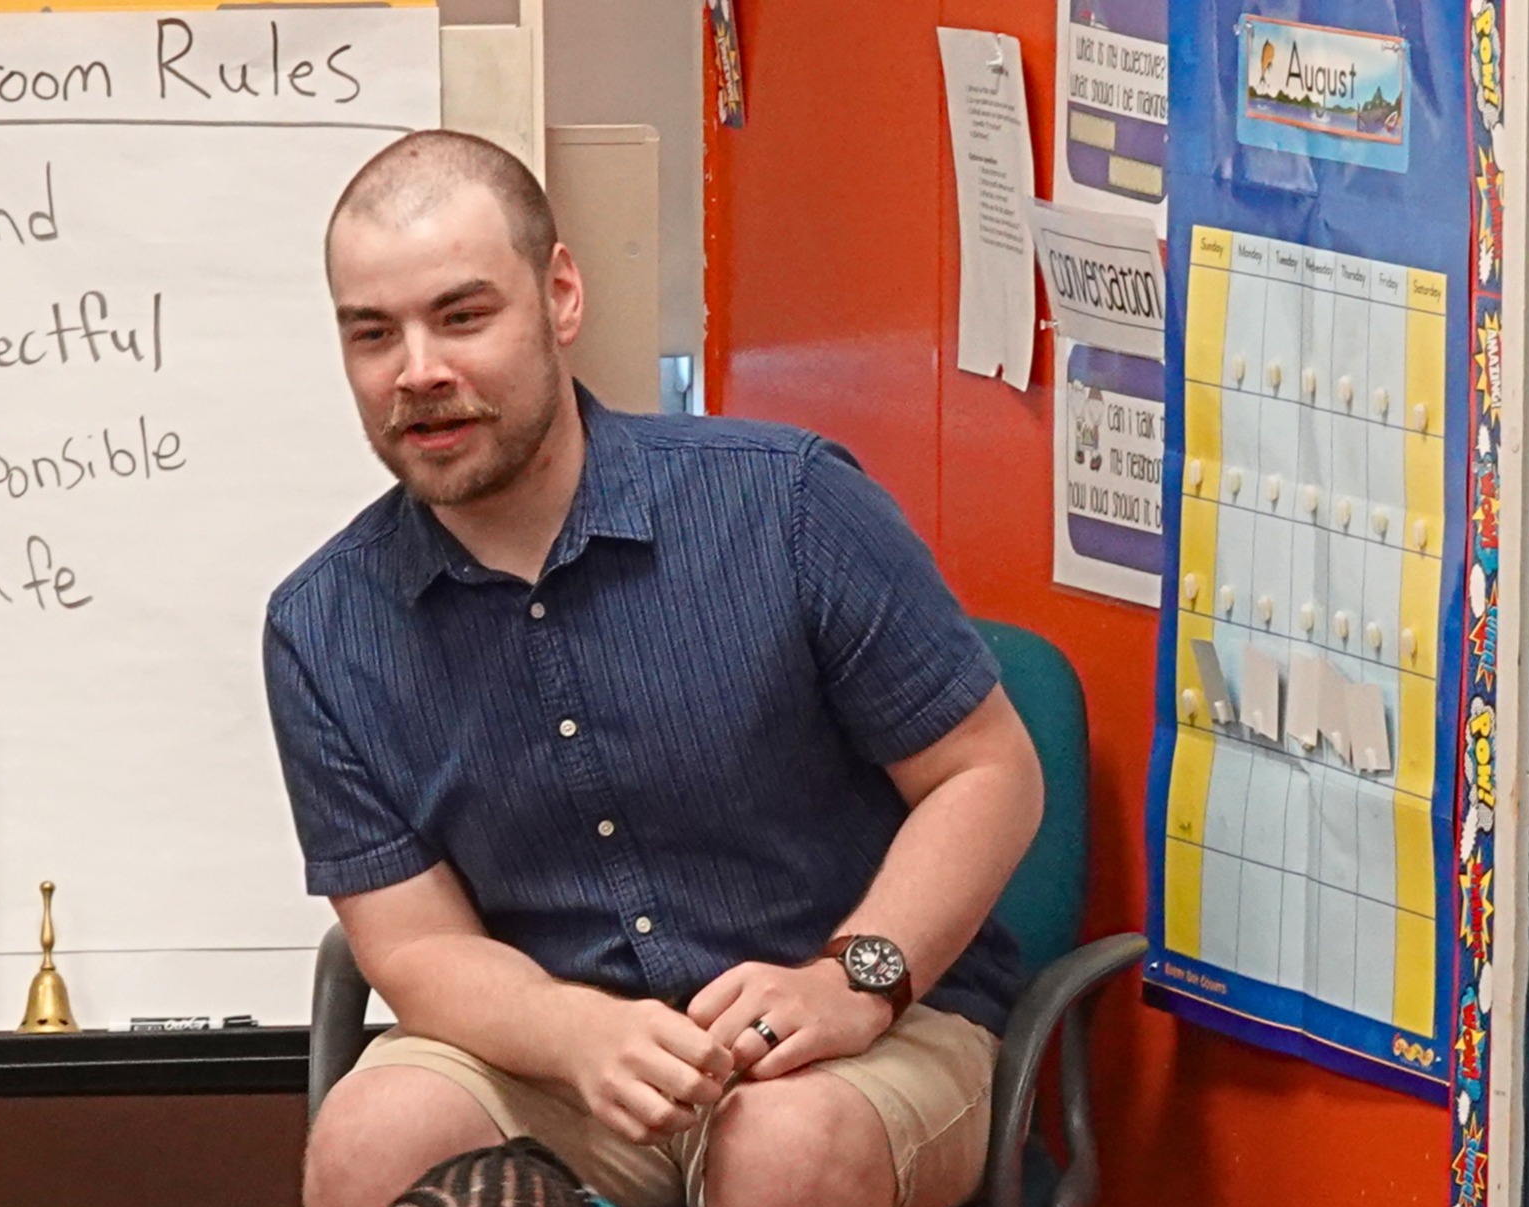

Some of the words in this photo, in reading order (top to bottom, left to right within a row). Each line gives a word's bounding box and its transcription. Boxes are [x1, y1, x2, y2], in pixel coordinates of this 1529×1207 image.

[155, 19, 362, 105] Rules
[1286, 41, 1357, 119] August
[1474, 9, 1500, 107] POW!
[1049, 249, 1163, 320] conversation
[1200, 237, 1224, 258] Sunday
[1238, 245, 1263, 264] Monday
[1275, 250, 1298, 273] Tuesday
[1305, 257, 1334, 280] Wednesday
[1341, 264, 1366, 289] Thursday
[1378, 271, 1399, 295] Friday
[1413, 279, 1442, 303] Saturday
[1485, 327, 1503, 410] AMAZING!
[1479, 472, 1500, 550] WOW!
[1470, 710, 1497, 808] POW!
[1462, 1002, 1482, 1081] WOW!
